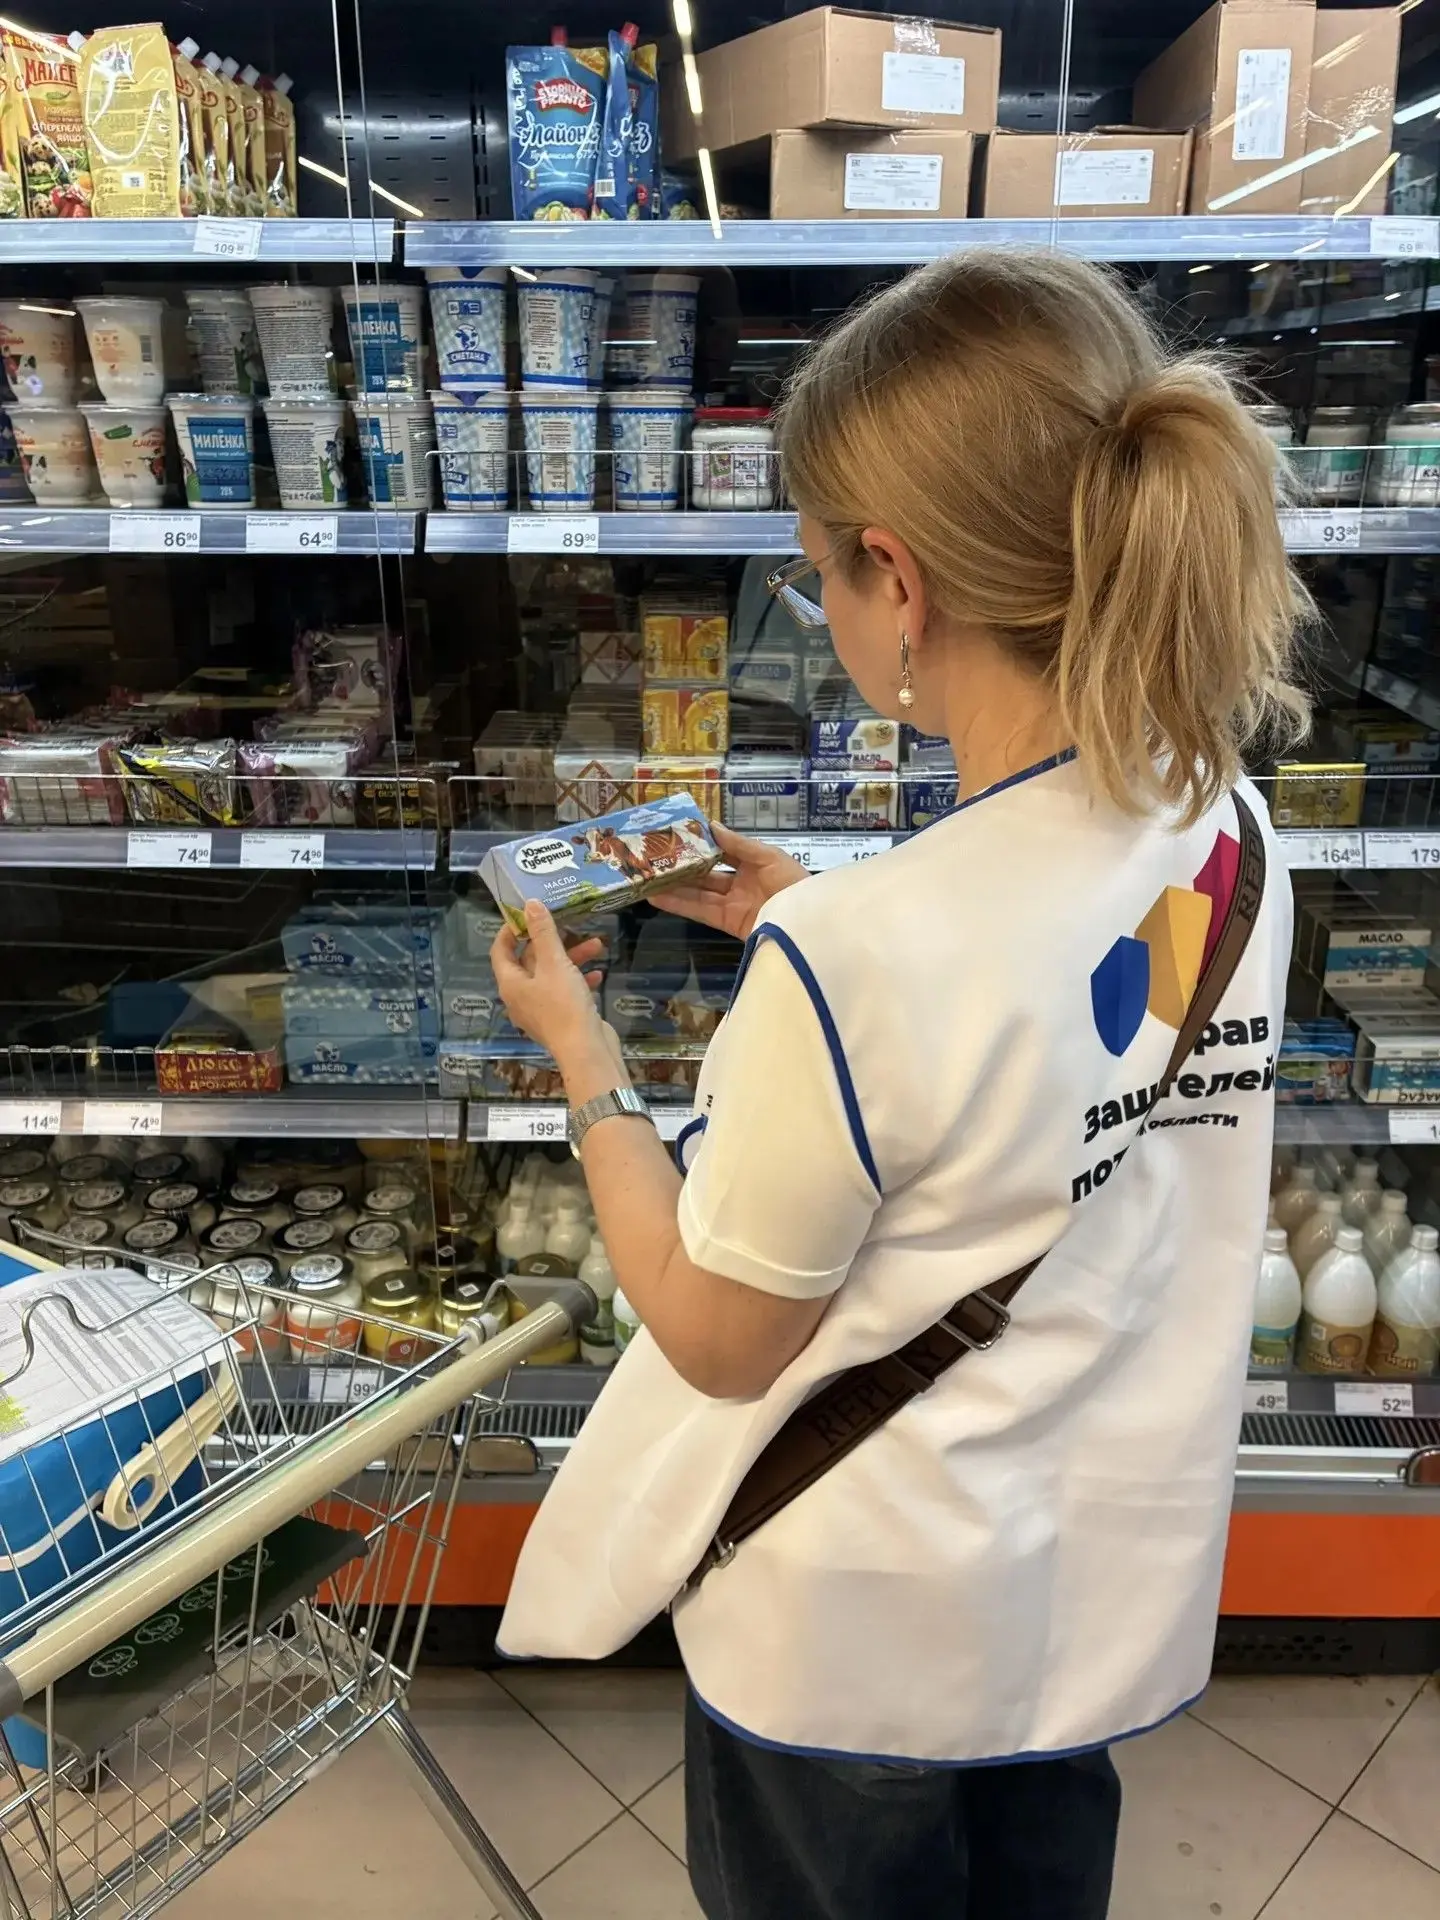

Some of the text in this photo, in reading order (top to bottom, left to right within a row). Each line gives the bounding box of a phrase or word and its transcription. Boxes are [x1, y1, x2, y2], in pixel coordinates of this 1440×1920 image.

[214, 243, 235, 254] 109
[164, 531, 186, 547] 86
[299, 531, 321, 547] 64
[562, 532, 584, 547] 89
[1323, 525, 1346, 542] 93
[178, 848, 199, 863] 74
[290, 849, 311, 864] 74
[523, 841, 565, 858] Южная
[1321, 849, 1350, 863] 164
[1411, 848, 1440, 863] 179
[520, 849, 574, 870] Губерния
[543, 875, 577, 890] МАСЛО
[1358, 932, 1404, 944] МАСЛО
[1194, 1016, 1269, 1056] рав
[186, 1057, 242, 1072] ЛЮКС
[311, 1063, 348, 1073] МАСЛО
[189, 1079, 248, 1090] ДРОЖЖИ
[22, 1115, 48, 1129] 114
[130, 1116, 150, 1131] 74
[1147, 1112, 1239, 1130] области
[529, 1123, 555, 1137] 199
[1382, 1398, 1402, 1413] 52
